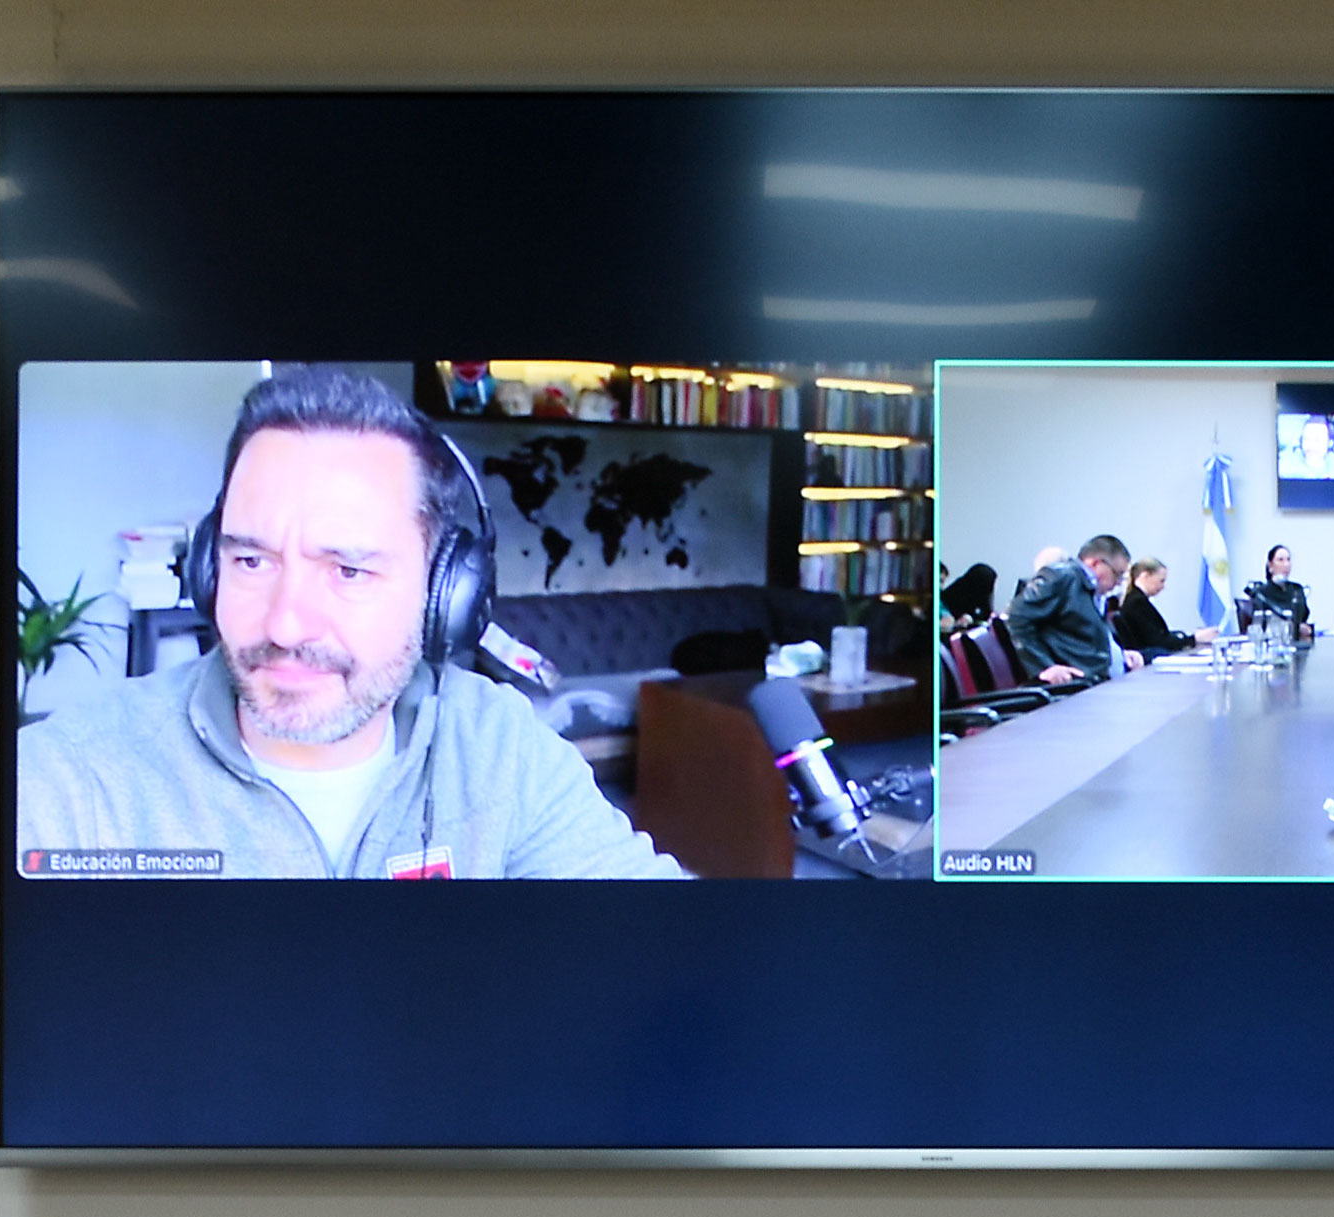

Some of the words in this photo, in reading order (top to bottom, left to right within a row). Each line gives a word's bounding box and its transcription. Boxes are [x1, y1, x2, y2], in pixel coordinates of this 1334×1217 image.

[49, 852, 132, 871] Educación
[135, 852, 220, 871] Emocional
[943, 854, 993, 872] Audio
[995, 855, 1032, 872] HLN
